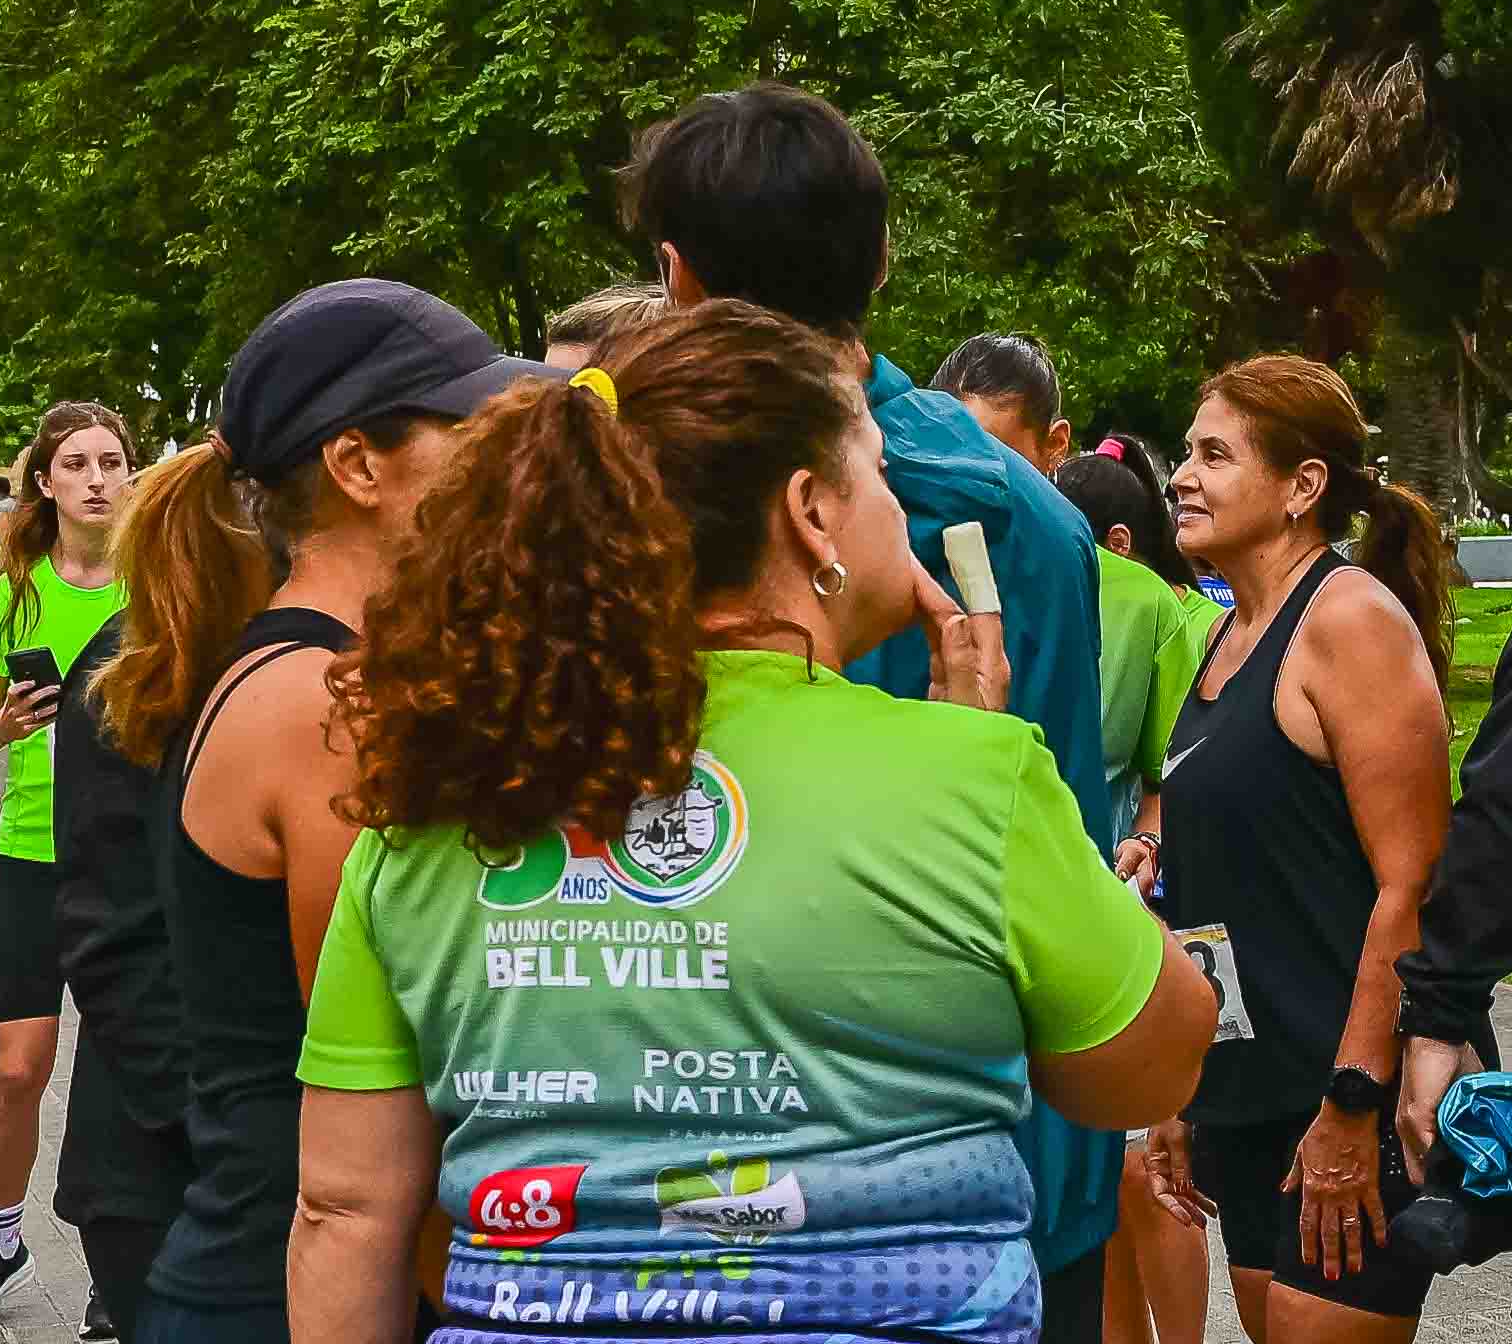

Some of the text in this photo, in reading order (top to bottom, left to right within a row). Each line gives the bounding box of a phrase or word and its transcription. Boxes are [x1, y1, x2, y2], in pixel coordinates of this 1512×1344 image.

[561, 873, 609, 901] AÑOS
[488, 919, 729, 945] MUNICIPALIDAD DE
[488, 946, 730, 989] BELL VILLE
[644, 1049, 799, 1080] POSTA
[634, 1086, 809, 1115] NATIVA
